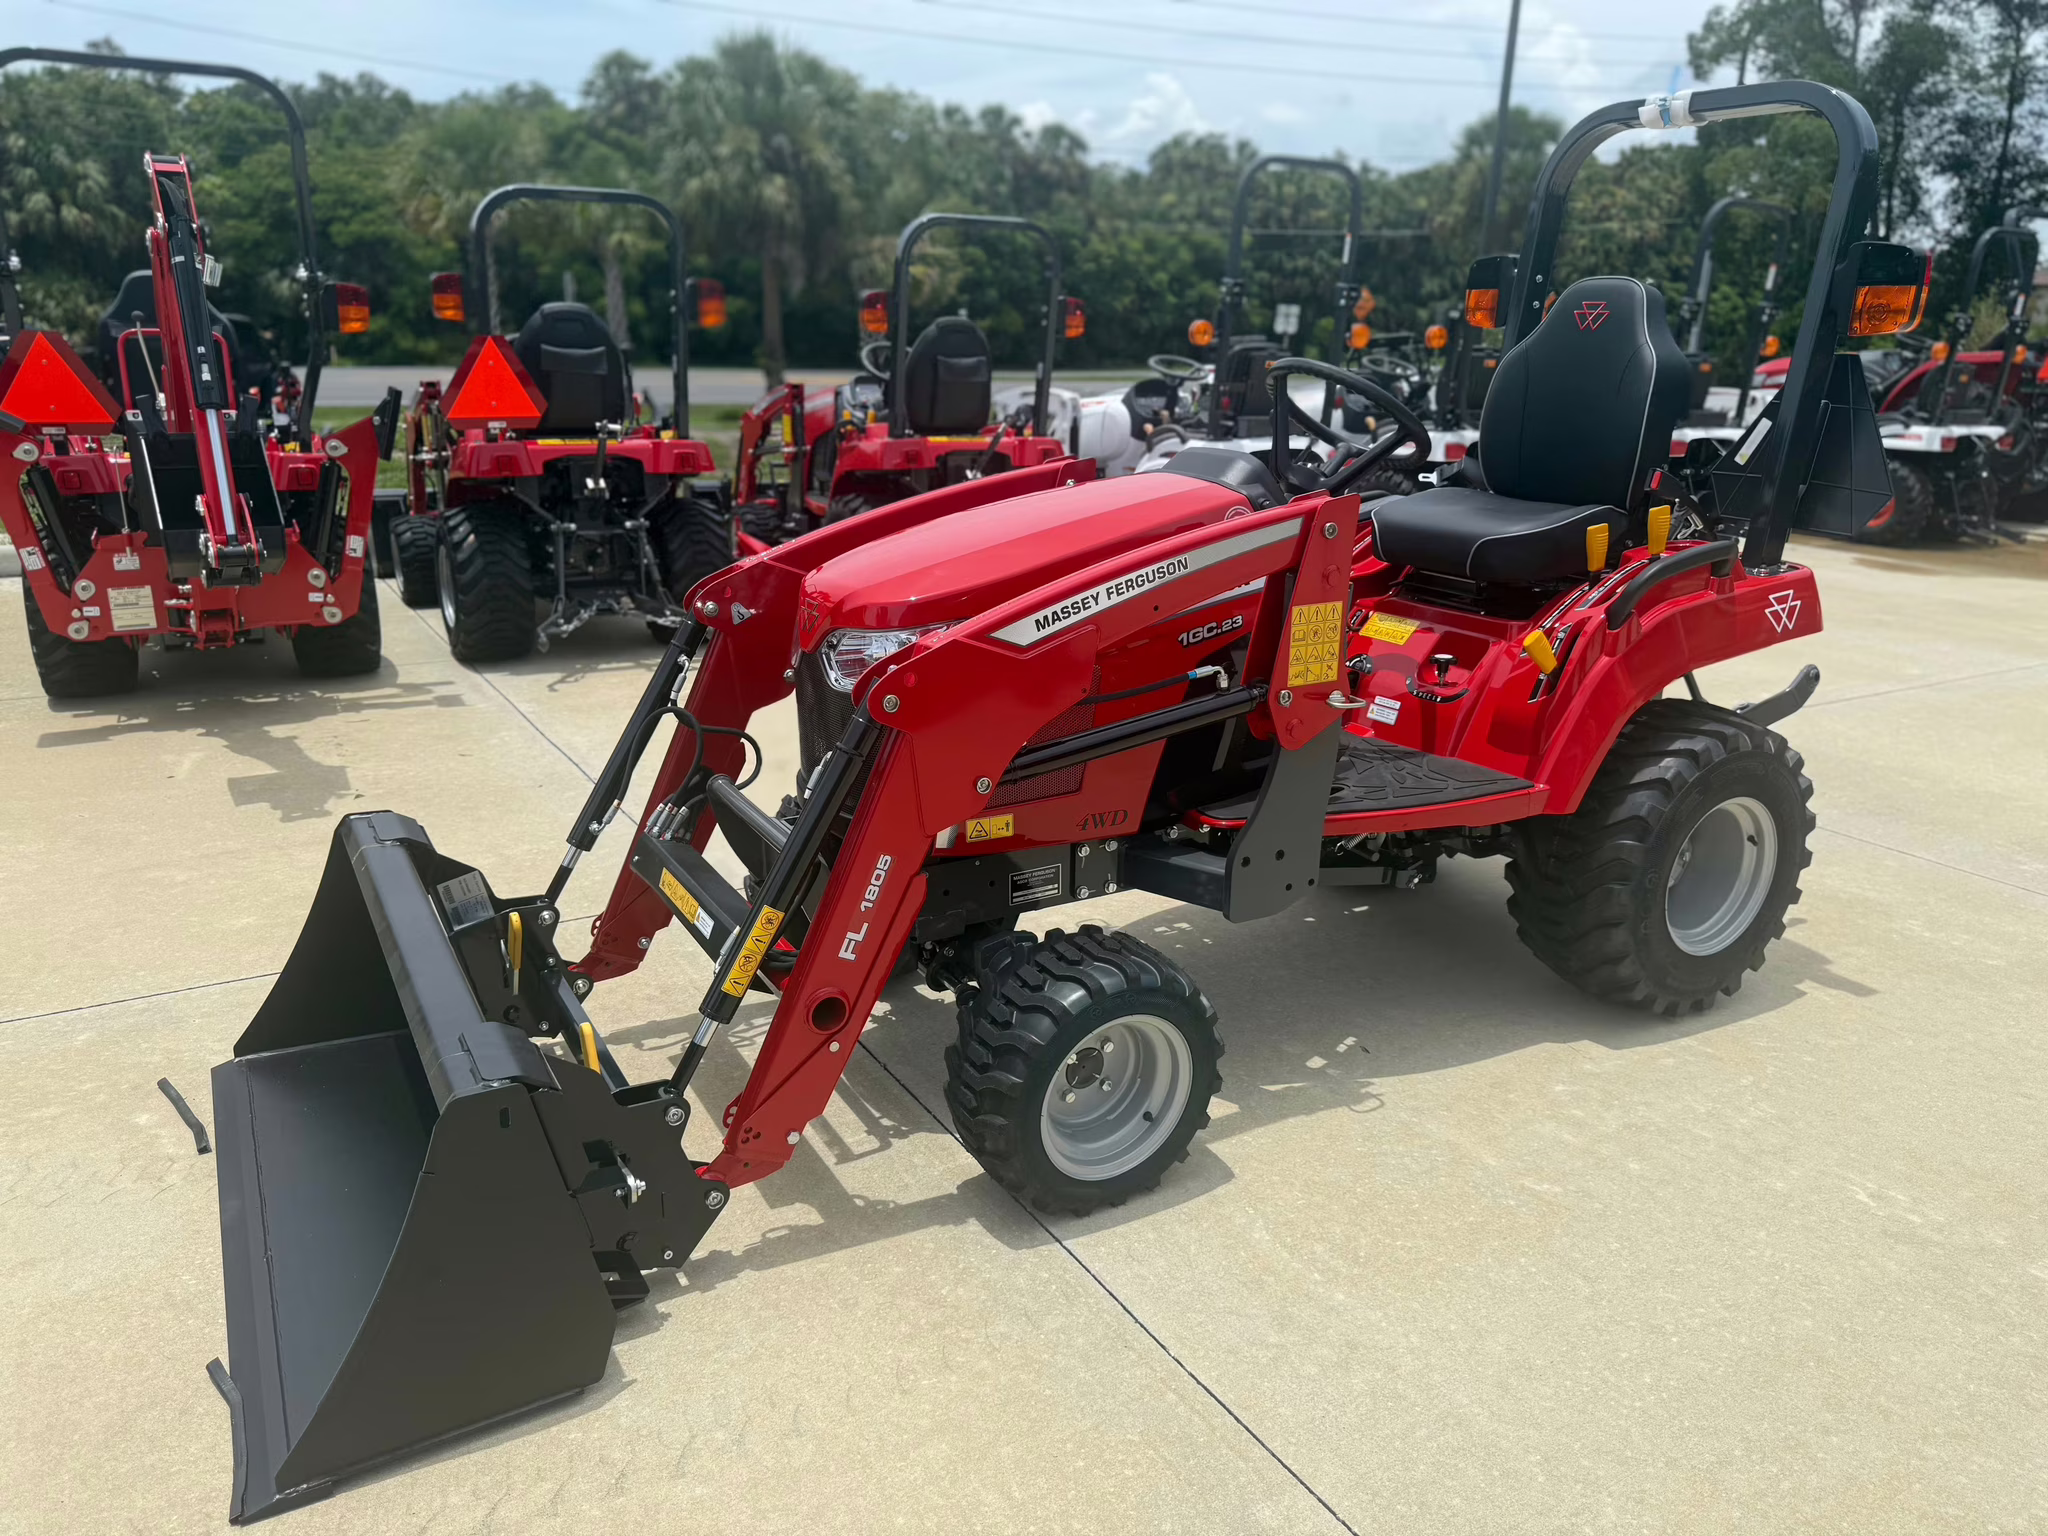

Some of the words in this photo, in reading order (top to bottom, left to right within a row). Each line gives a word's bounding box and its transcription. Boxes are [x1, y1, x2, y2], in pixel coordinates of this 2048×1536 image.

[1034, 591, 1101, 632] MASSEY
[1106, 555, 1190, 601] FERGUSON
[1177, 614, 1243, 647] 1GC.23
[1076, 809, 1129, 832] 4WD
[838, 922, 869, 961] FL
[860, 854, 892, 912] 1805
